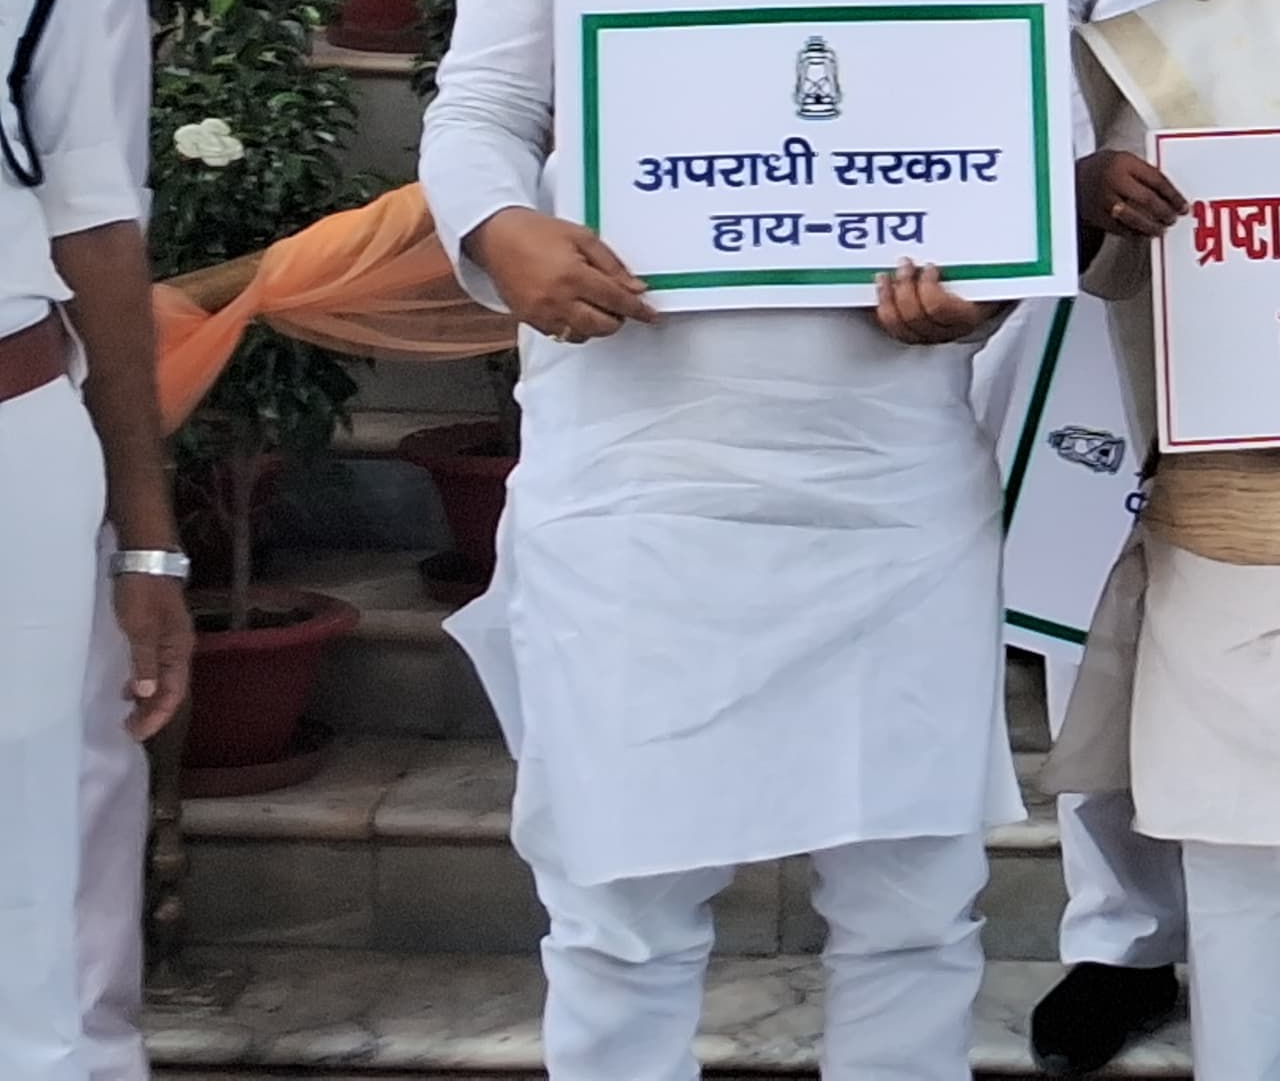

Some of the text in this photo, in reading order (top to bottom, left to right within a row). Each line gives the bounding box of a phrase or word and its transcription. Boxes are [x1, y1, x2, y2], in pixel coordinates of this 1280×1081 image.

[633, 137, 1002, 192] अपराधी सरकार
[710, 212, 927, 252] हाय-हाय
